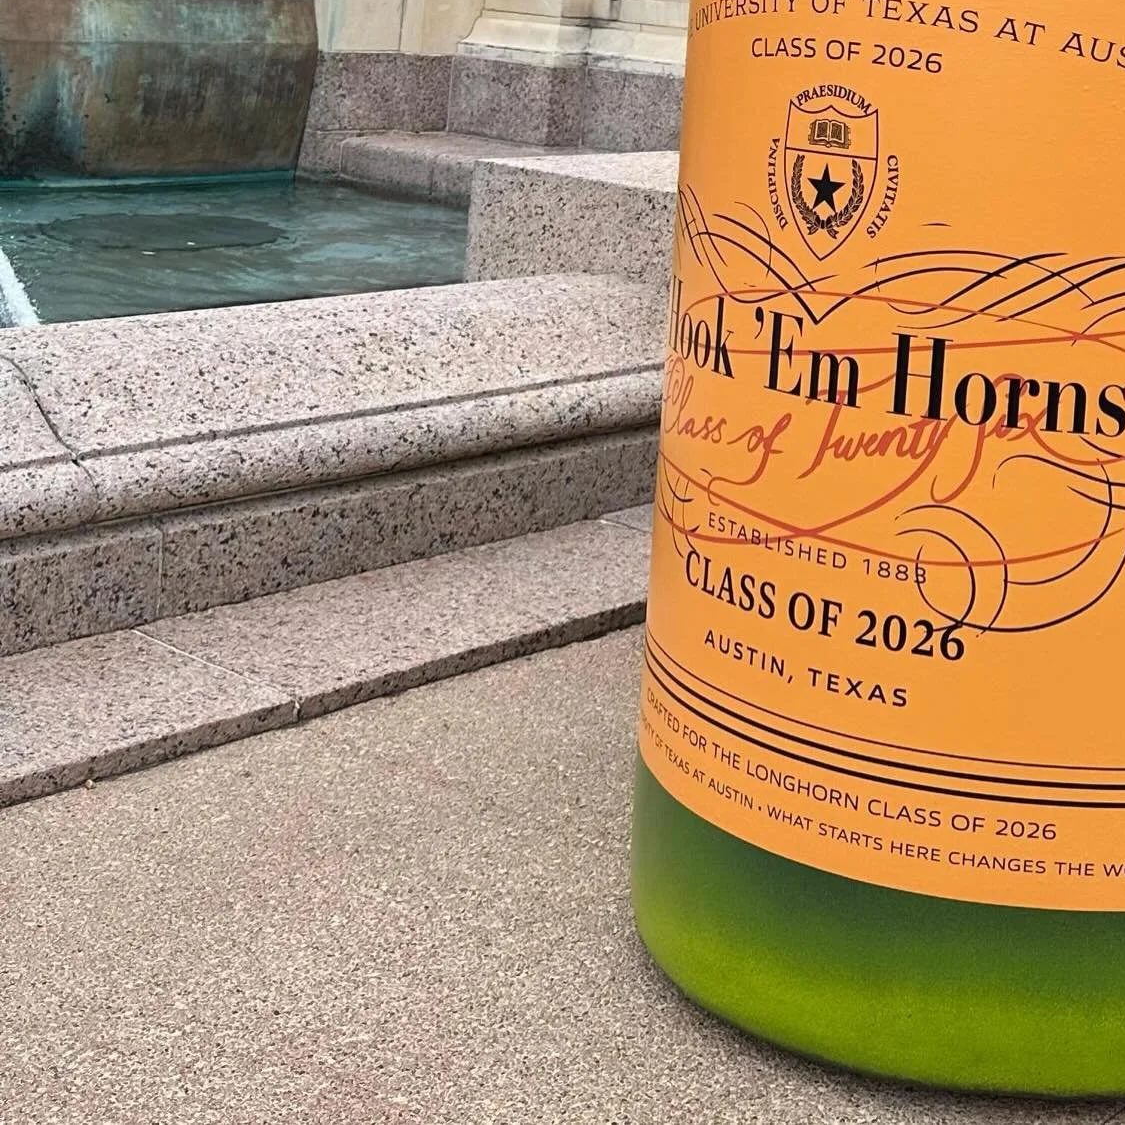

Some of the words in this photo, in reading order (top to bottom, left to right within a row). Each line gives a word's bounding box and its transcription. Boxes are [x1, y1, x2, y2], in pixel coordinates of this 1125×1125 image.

[751, 37, 816, 58] CLASS
[826, 39, 861, 62] OF
[871, 44, 943, 74] 2026
[994, 17, 1046, 47] AT
[796, 84, 872, 114] PRAESIDIUM
[768, 138, 788, 231] DISCIPLINA
[866, 154, 899, 239] CIVITATIS
[728, 412, 786, 486] of
[708, 512, 848, 569] ESTABLISHED
[685, 550, 776, 619] CLASS
[788, 592, 843, 638] OF
[855, 610, 965, 661] 2026
[704, 630, 794, 683] AUSTIN,
[808, 668, 907, 707] TEXAS
[647, 687, 680, 733] CRAFTED
[683, 725, 707, 753] FOR
[712, 742, 741, 770] THE
[746, 760, 859, 811] LONGHORN
[867, 798, 942, 827] CLASS
[951, 814, 986, 833] OF
[995, 819, 1057, 840] 2026
[665, 744, 690, 775] TEXAS
[692, 768, 706, 784] AT
[708, 778, 754, 809] AUSTIN
[767, 804, 813, 831] WHAT
[818, 822, 883, 851] STARTS
[890, 840, 941, 862] HERE
[949, 851, 1046, 874] CHANGES
[1054, 861, 1094, 876] THE
